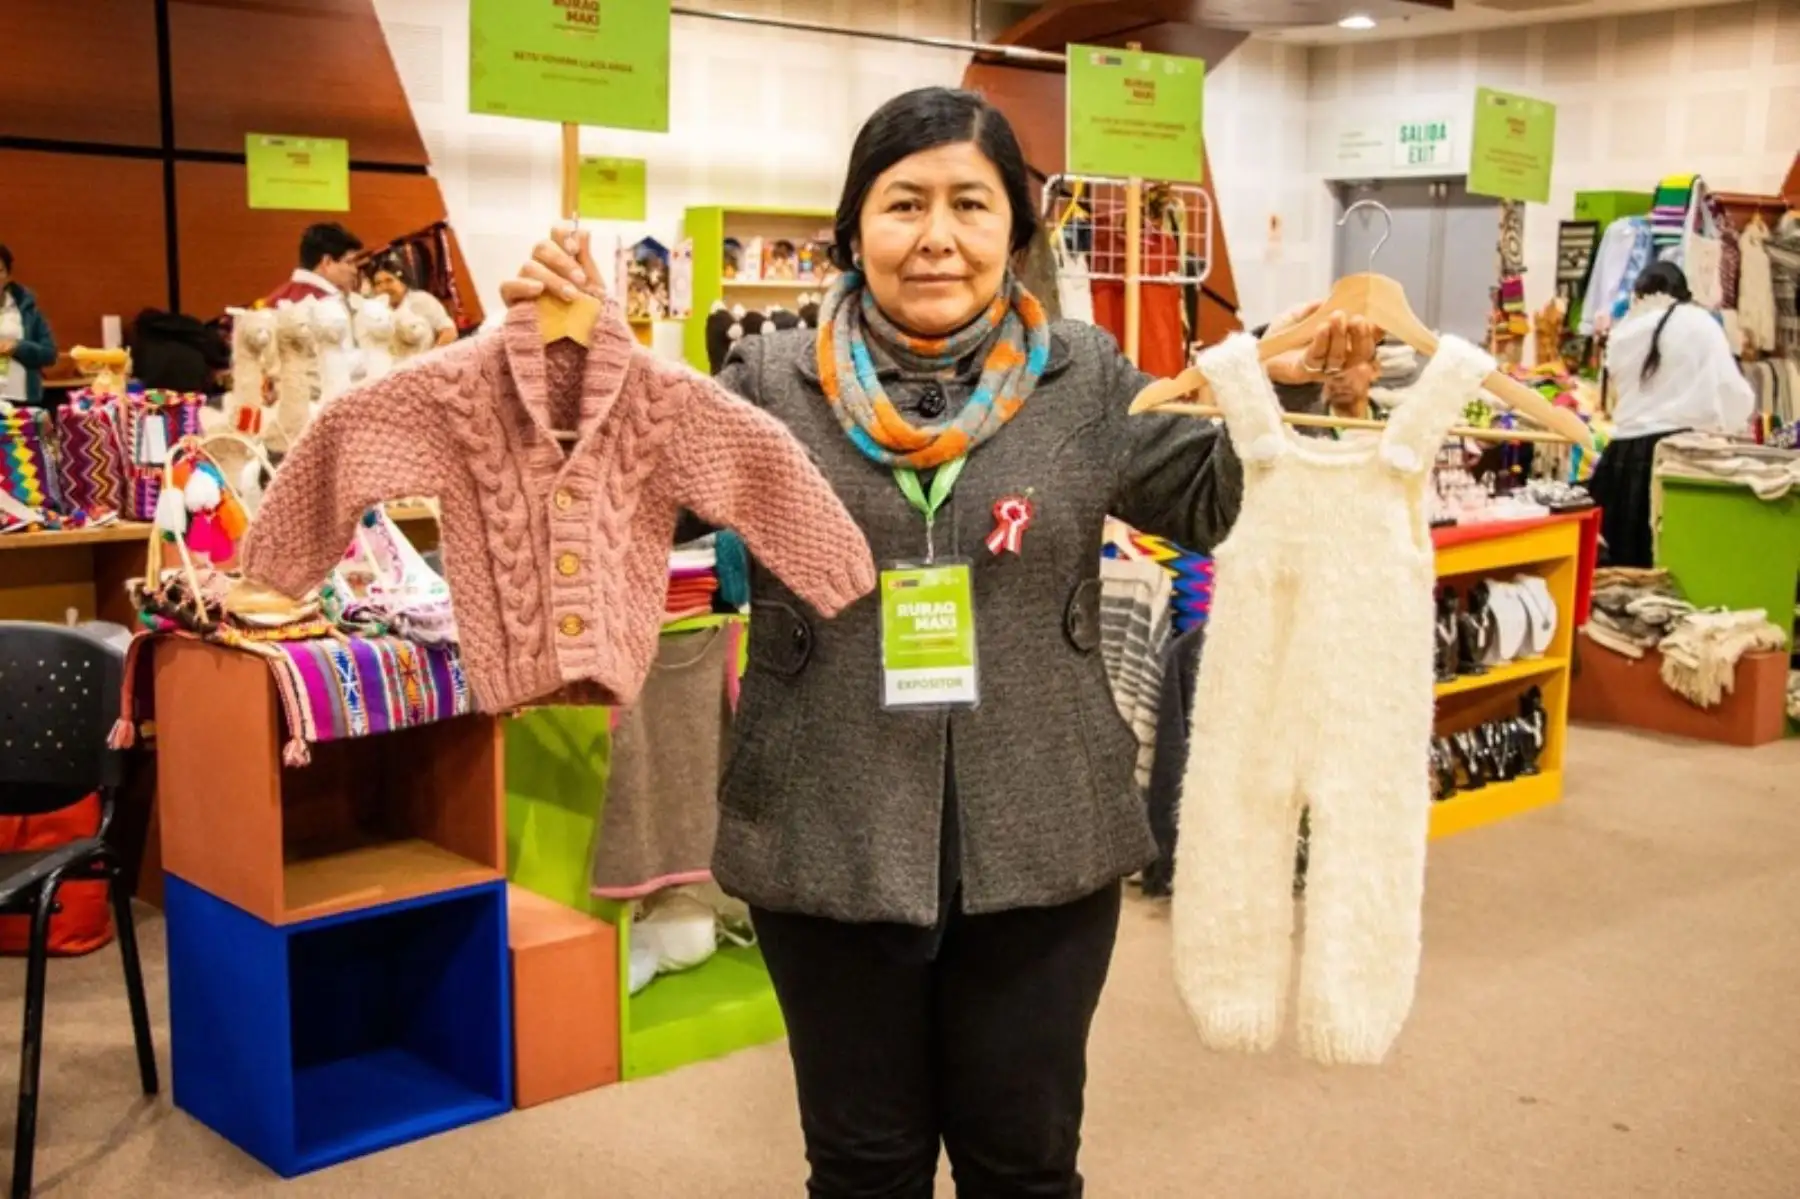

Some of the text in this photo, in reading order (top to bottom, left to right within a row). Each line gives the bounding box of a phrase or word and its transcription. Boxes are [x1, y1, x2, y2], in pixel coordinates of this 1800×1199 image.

[566, 11, 600, 27] MAKI
[1400, 123, 1447, 143] SALIDA
[1408, 145, 1435, 164] EXIT
[897, 601, 957, 617] RURAQ
[915, 615, 957, 631] MAKI
[897, 677, 963, 690] EXPOSITOR
